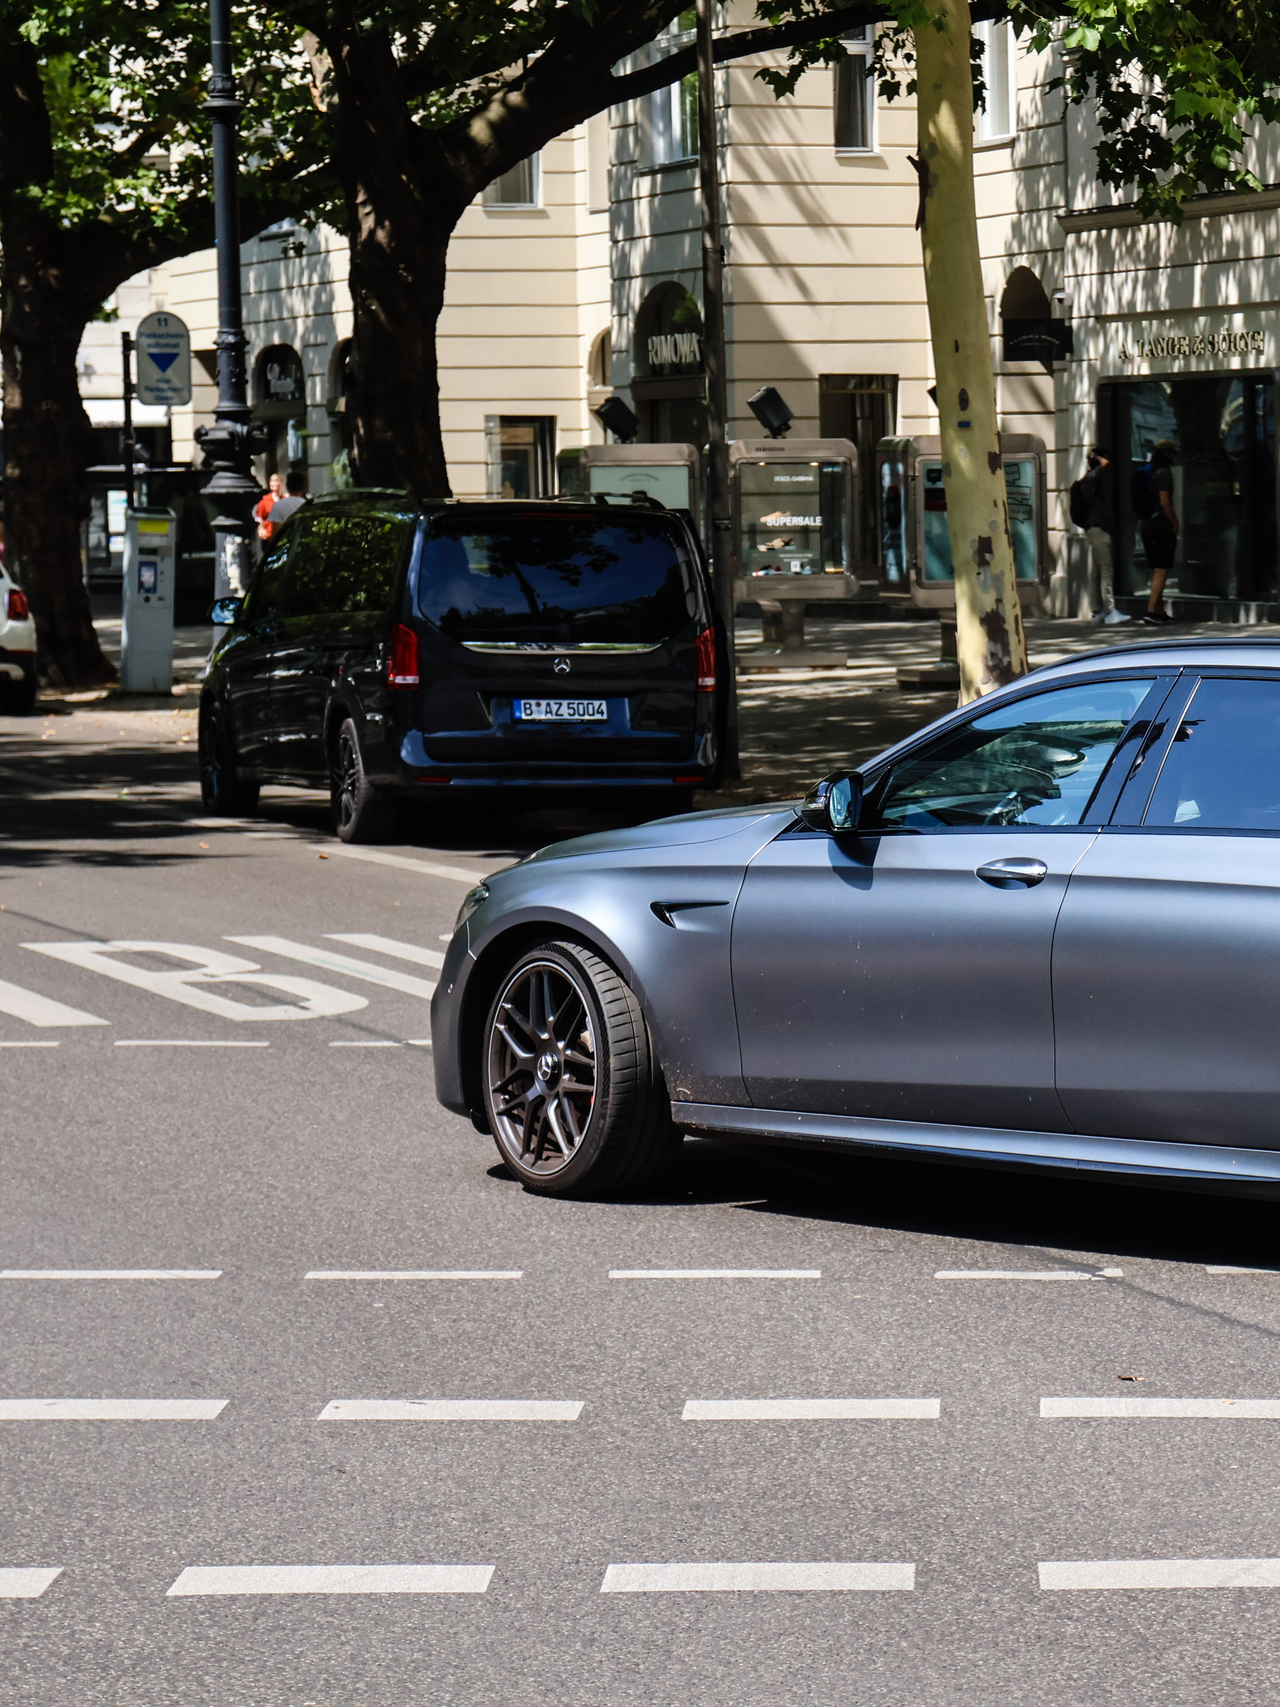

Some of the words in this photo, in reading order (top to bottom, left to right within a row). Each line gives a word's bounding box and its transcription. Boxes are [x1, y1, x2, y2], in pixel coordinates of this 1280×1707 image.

[157, 317, 168, 327] 11
[648, 332, 701, 365] RIMOWA
[1136, 335, 1190, 357] LANGE
[1193, 334, 1205, 355] &
[1208, 326, 1265, 353] SÖHNE
[766, 516, 822, 526] SUPERSALE
[523, 702, 533, 717] B
